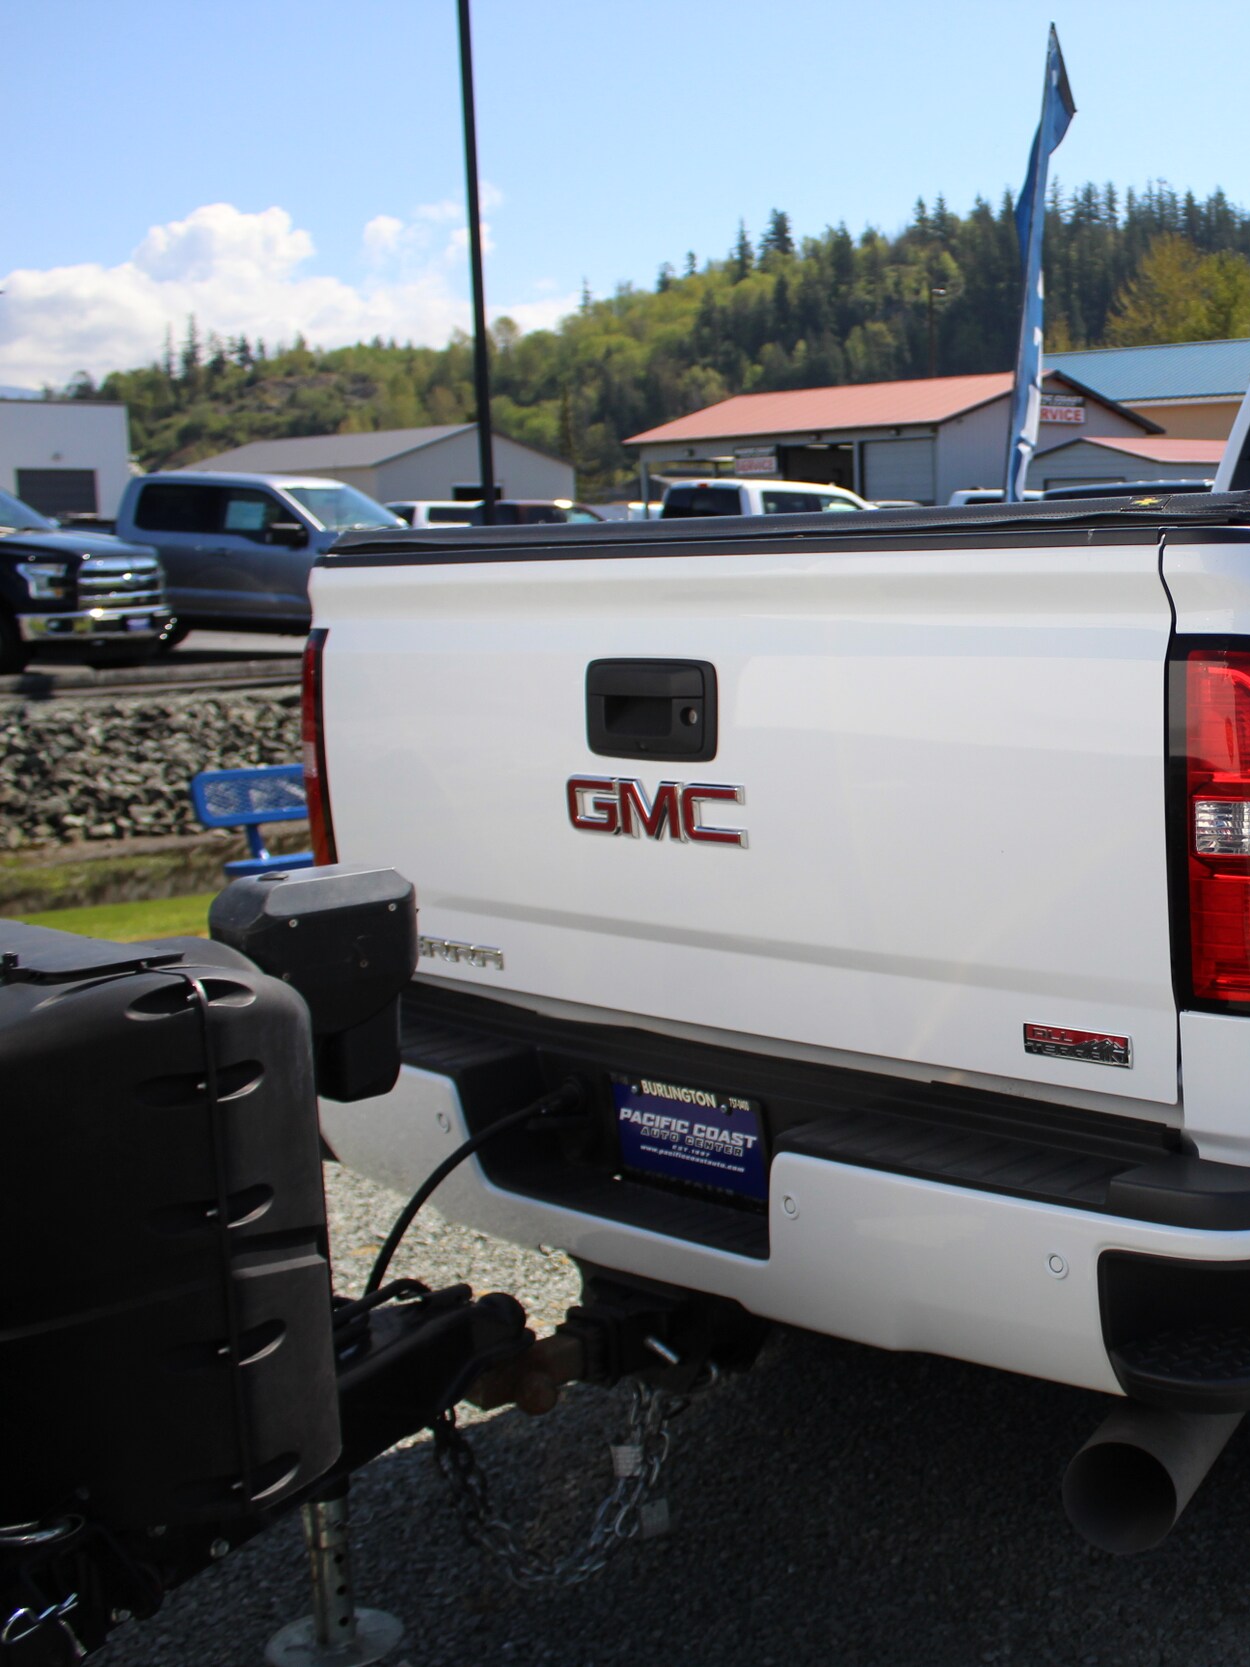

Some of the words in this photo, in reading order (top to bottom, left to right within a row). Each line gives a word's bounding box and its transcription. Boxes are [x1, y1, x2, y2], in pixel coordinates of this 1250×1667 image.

[1040, 407, 1082, 422] RVICE
[567, 774, 749, 849] GMC
[1033, 1027, 1073, 1041] ALL
[1027, 1042, 1124, 1063] TERRAIN
[640, 1080, 716, 1108] BURLINGTON
[619, 1107, 690, 1134] PACIFIC
[692, 1123, 758, 1149] COAST
[640, 1126, 679, 1142] AUTO
[685, 1135, 744, 1157] CENTER
